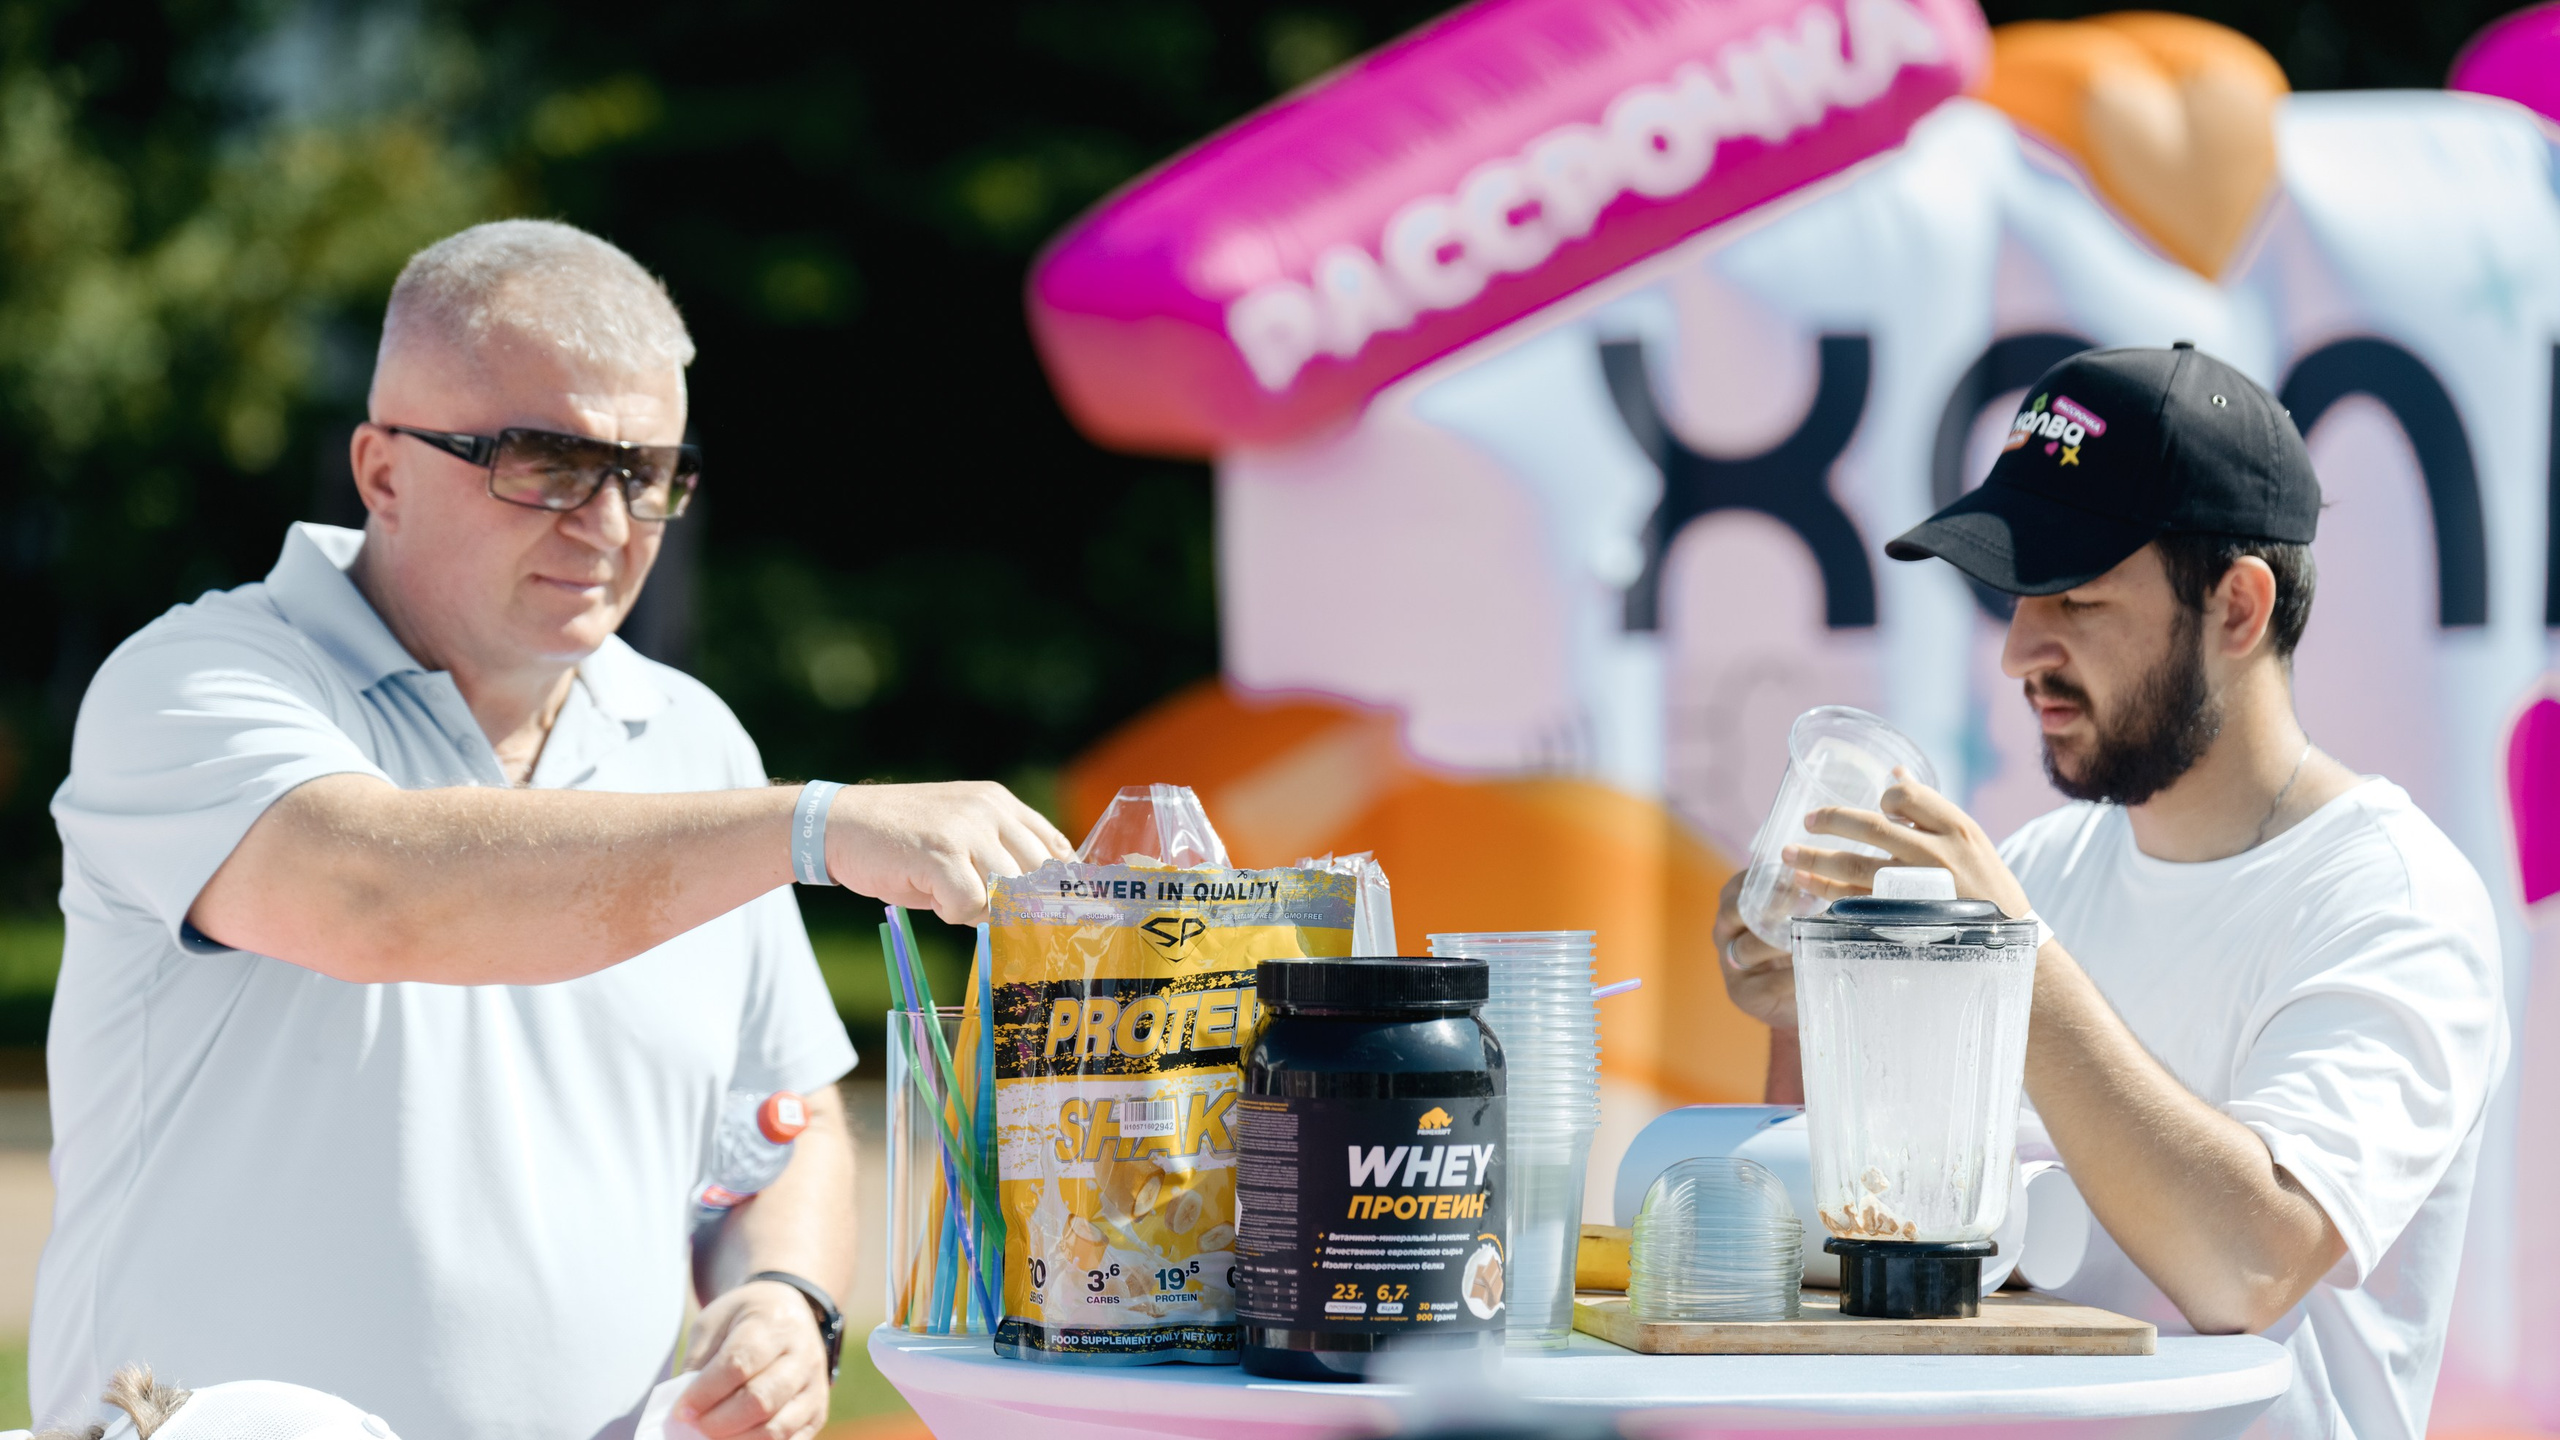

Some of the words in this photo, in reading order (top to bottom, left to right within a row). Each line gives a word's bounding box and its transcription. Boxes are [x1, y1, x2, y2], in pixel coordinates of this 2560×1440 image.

[803, 800, 820, 838] GLORIA
[1060, 880, 1146, 900] POWER
[1157, 881, 1184, 901] IN
[1193, 881, 1279, 902] QUALITY
[1020, 911, 1050, 920] GLUTEN
[1050, 911, 1066, 920] FREE
[1086, 912, 1108, 920] SUGAR
[1109, 913, 1125, 921] FREE
[1284, 911, 1302, 920] GMO
[1303, 912, 1324, 921] FREE
[1044, 986, 1264, 1058] PROTEI
[1055, 1089, 1237, 1163] SHAK
[1348, 1143, 1496, 1188] WHEY
[1347, 1193, 1486, 1220] ПРОТЕИН
[1328, 1232, 1437, 1243] Витаминно-минеральный
[1437, 1233, 1471, 1242] комплекс
[1325, 1247, 1386, 1256] Качественное
[1387, 1248, 1441, 1257] европейское
[1441, 1247, 1464, 1256] сырье
[1321, 1261, 1353, 1270] Изолят
[1353, 1262, 1421, 1272] сывороточного
[1421, 1261, 1445, 1271] белка
[1086, 1295, 1120, 1304] CARBS
[1155, 1293, 1198, 1303] PROTEIN
[1418, 1302, 1430, 1311] 30
[1415, 1313, 1433, 1322] 900
[1051, 1334, 1079, 1345] FOOD
[1081, 1334, 1152, 1346] SUPPLEMENT
[1154, 1332, 1180, 1344] ONLY
[1182, 1332, 1204, 1343] NET
[1206, 1333, 1226, 1343] WT.
